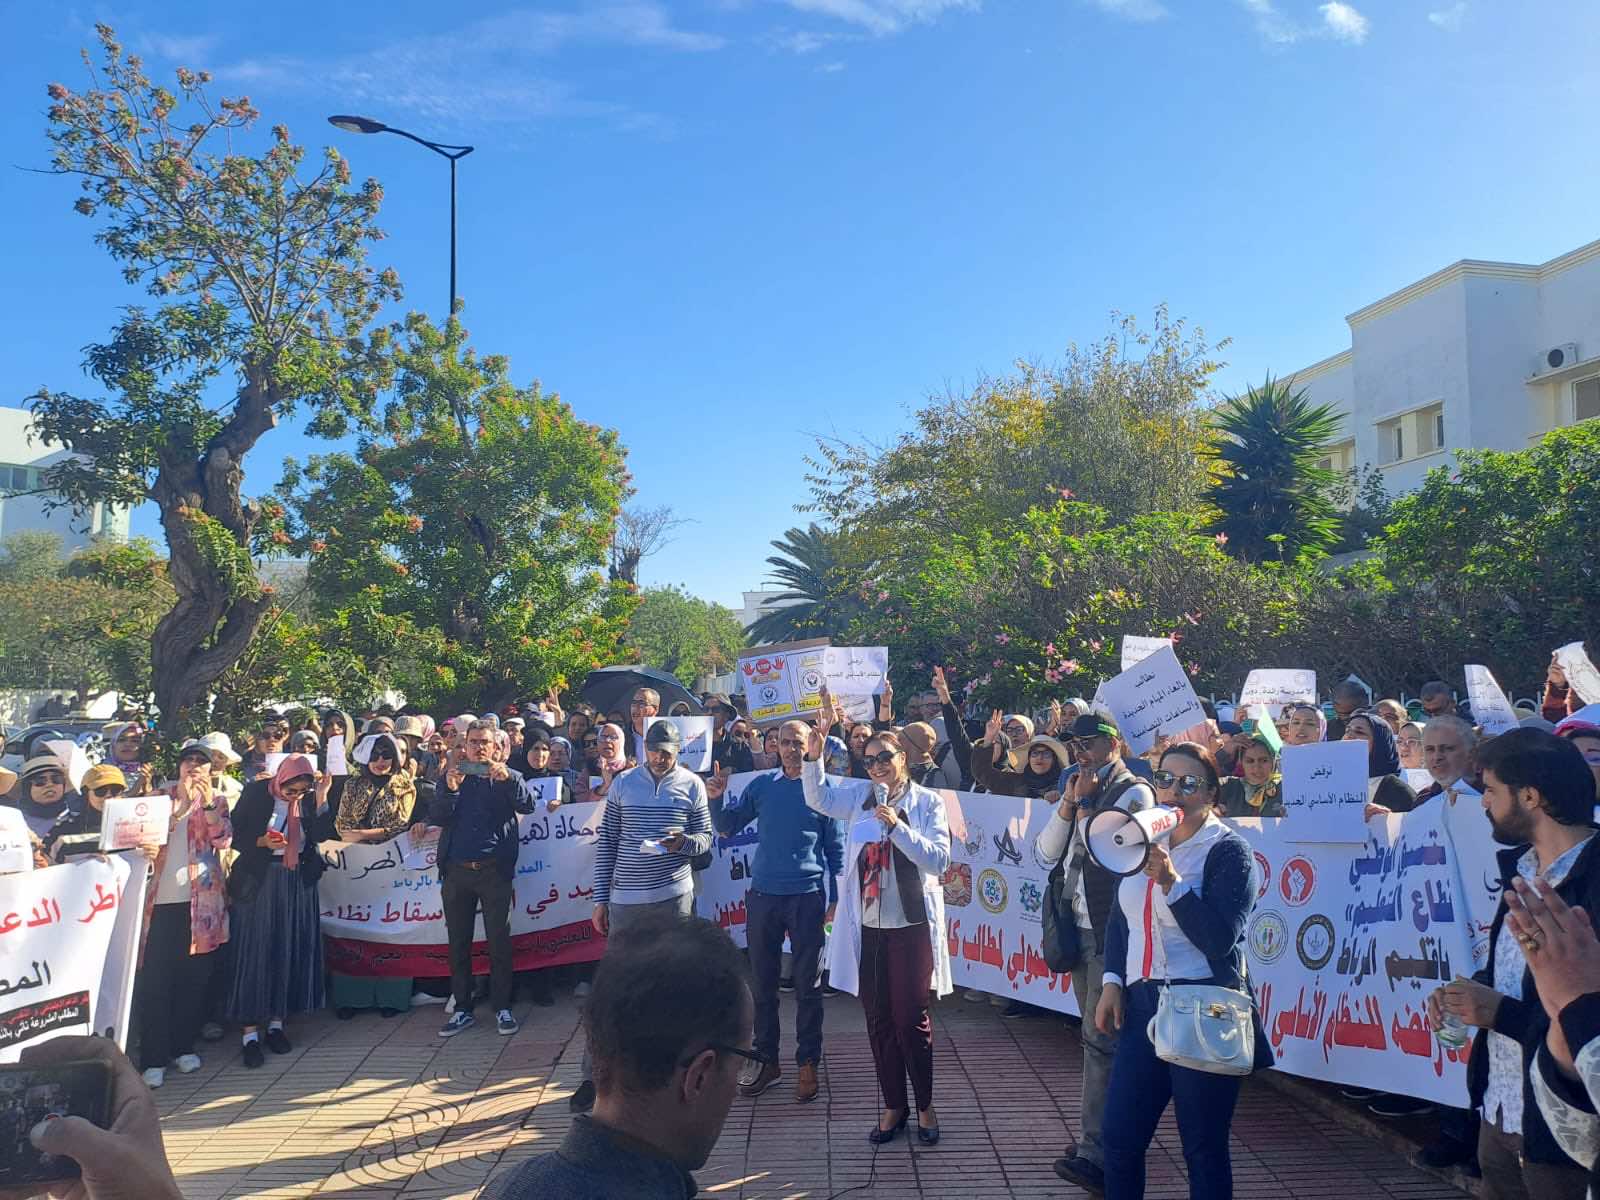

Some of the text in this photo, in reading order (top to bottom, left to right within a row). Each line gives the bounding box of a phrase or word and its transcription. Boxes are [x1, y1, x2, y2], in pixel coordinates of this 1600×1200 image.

[0, 896, 61, 935] الدع
[380, 901, 444, 924] سقاط
[526, 882, 560, 920] في
